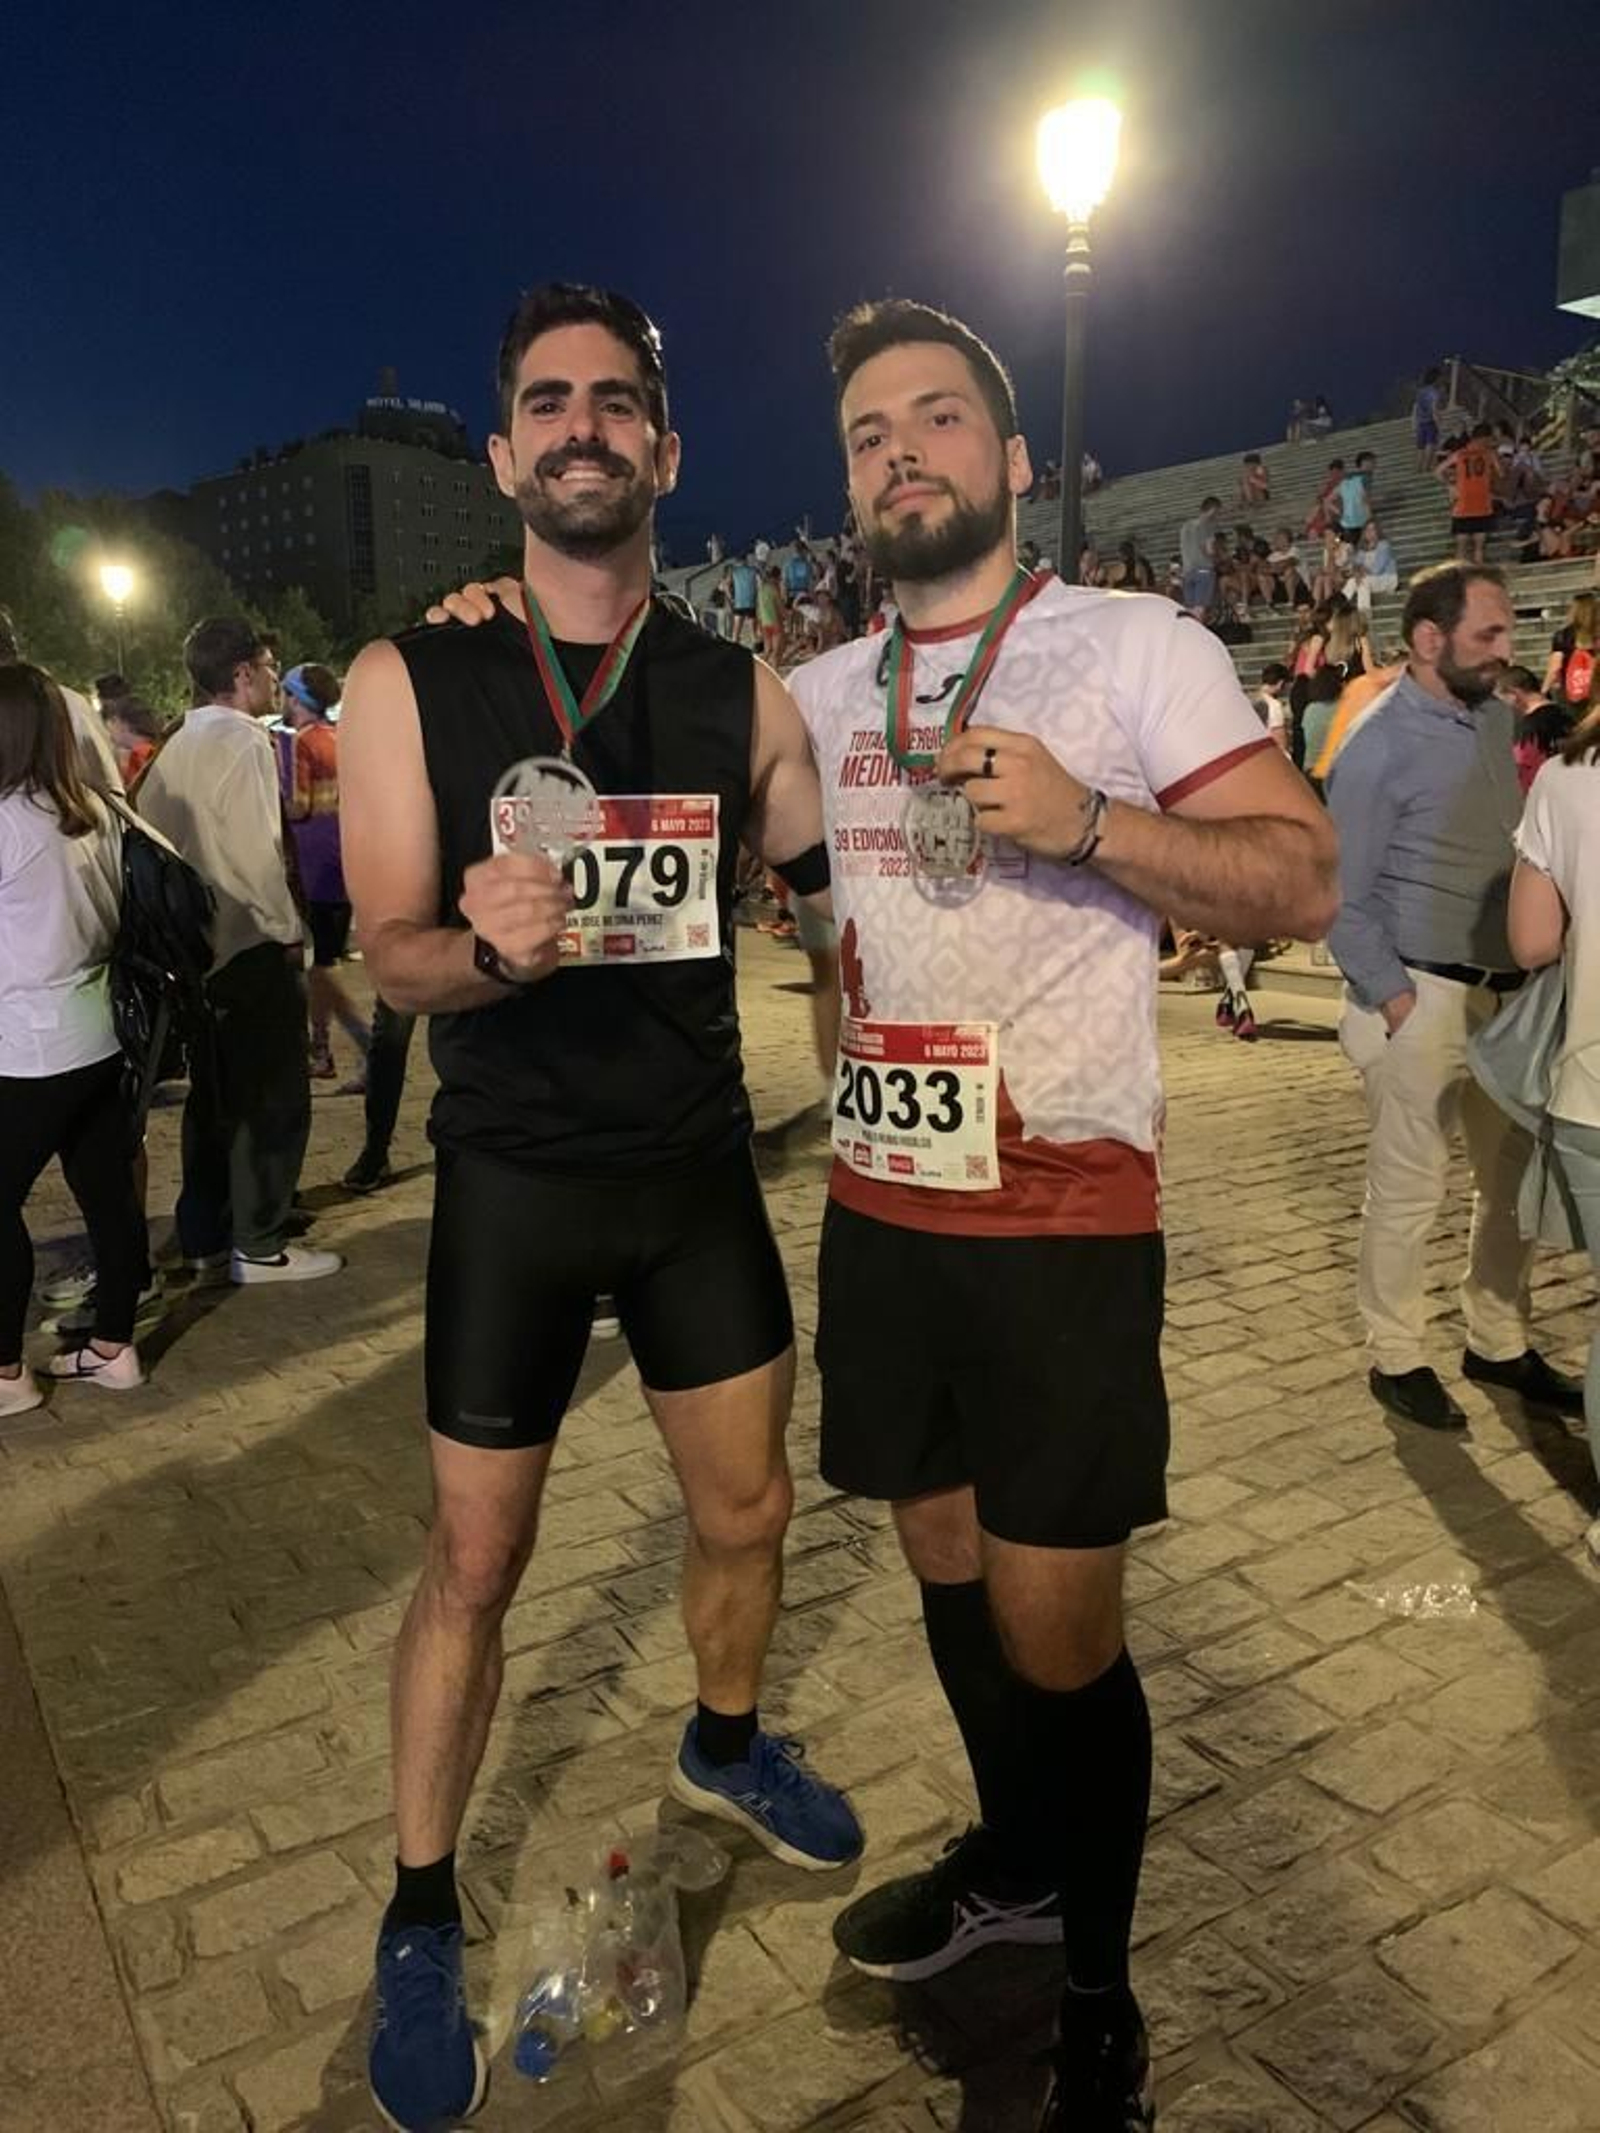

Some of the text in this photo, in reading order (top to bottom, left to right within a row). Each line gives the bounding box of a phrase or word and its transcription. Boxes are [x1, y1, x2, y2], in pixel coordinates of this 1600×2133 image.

[1465, 457, 1485, 478] 10
[839, 754, 903, 788] MEDIA
[834, 827, 850, 852] 39
[562, 845, 690, 910] 079
[879, 857, 911, 877] 2023
[837, 1059, 964, 1133] 2033
